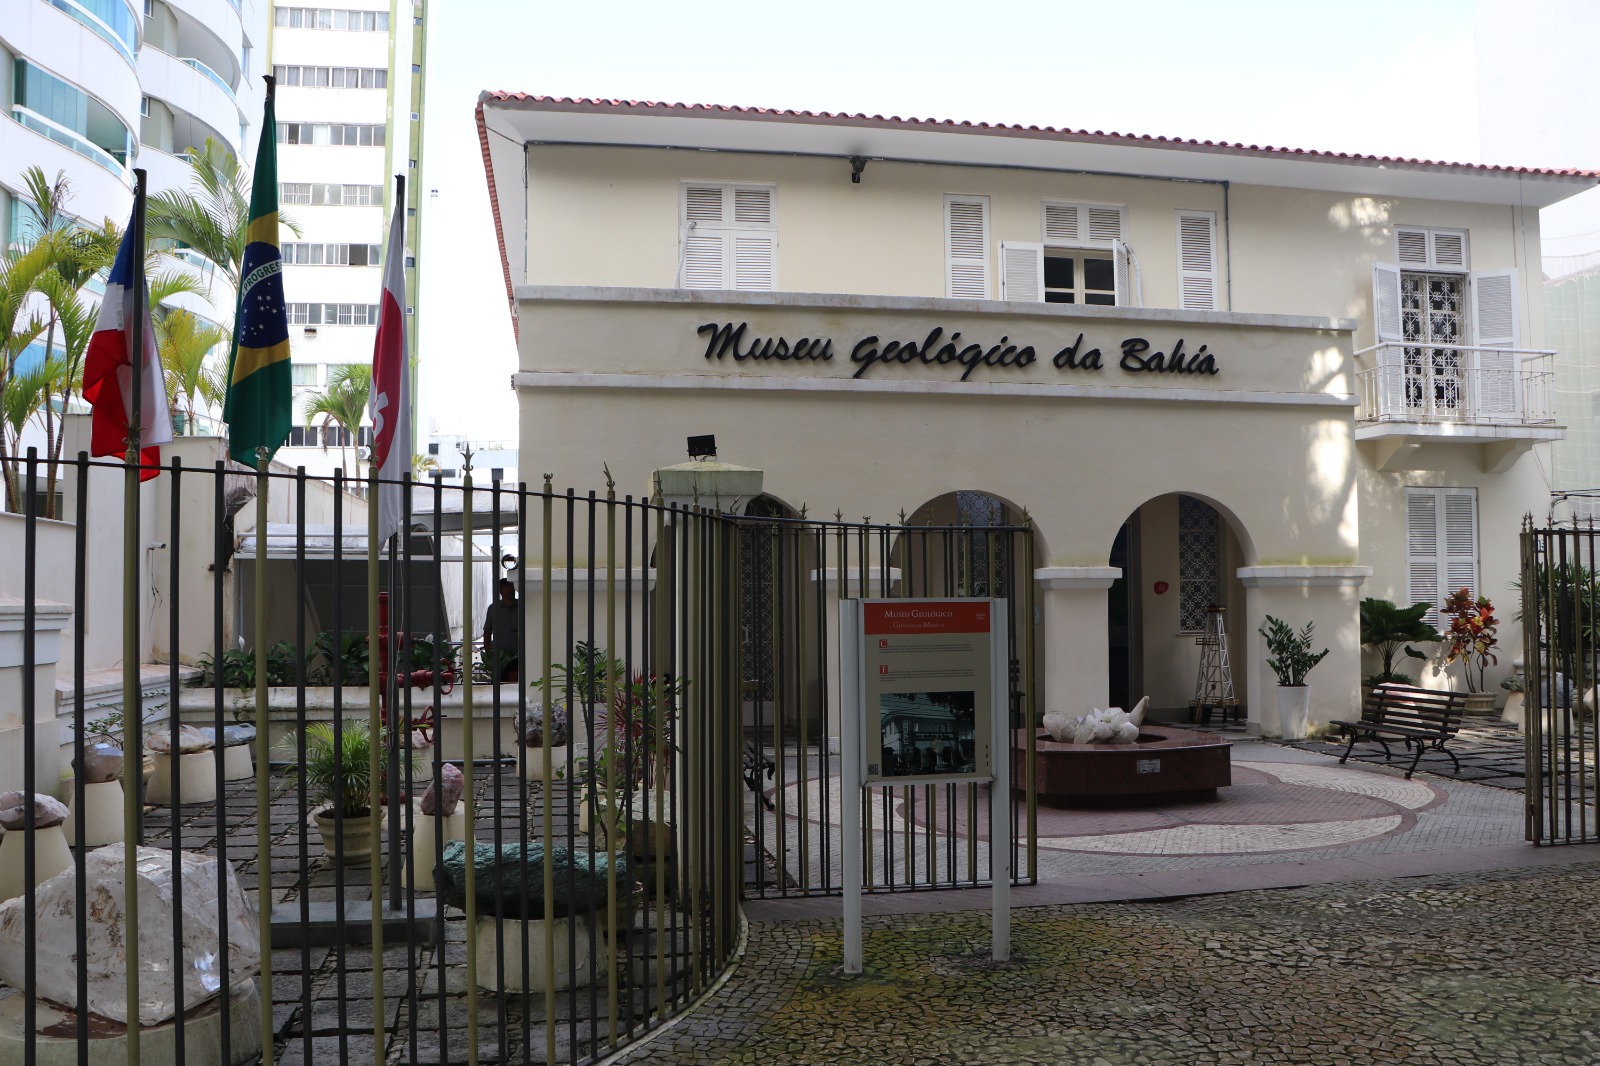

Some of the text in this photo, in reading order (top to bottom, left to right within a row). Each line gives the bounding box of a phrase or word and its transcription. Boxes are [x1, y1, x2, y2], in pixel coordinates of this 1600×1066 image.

[243, 261, 282, 291] PROGRES
[697, 322, 1219, 381] Museu Geológico da Bahia
